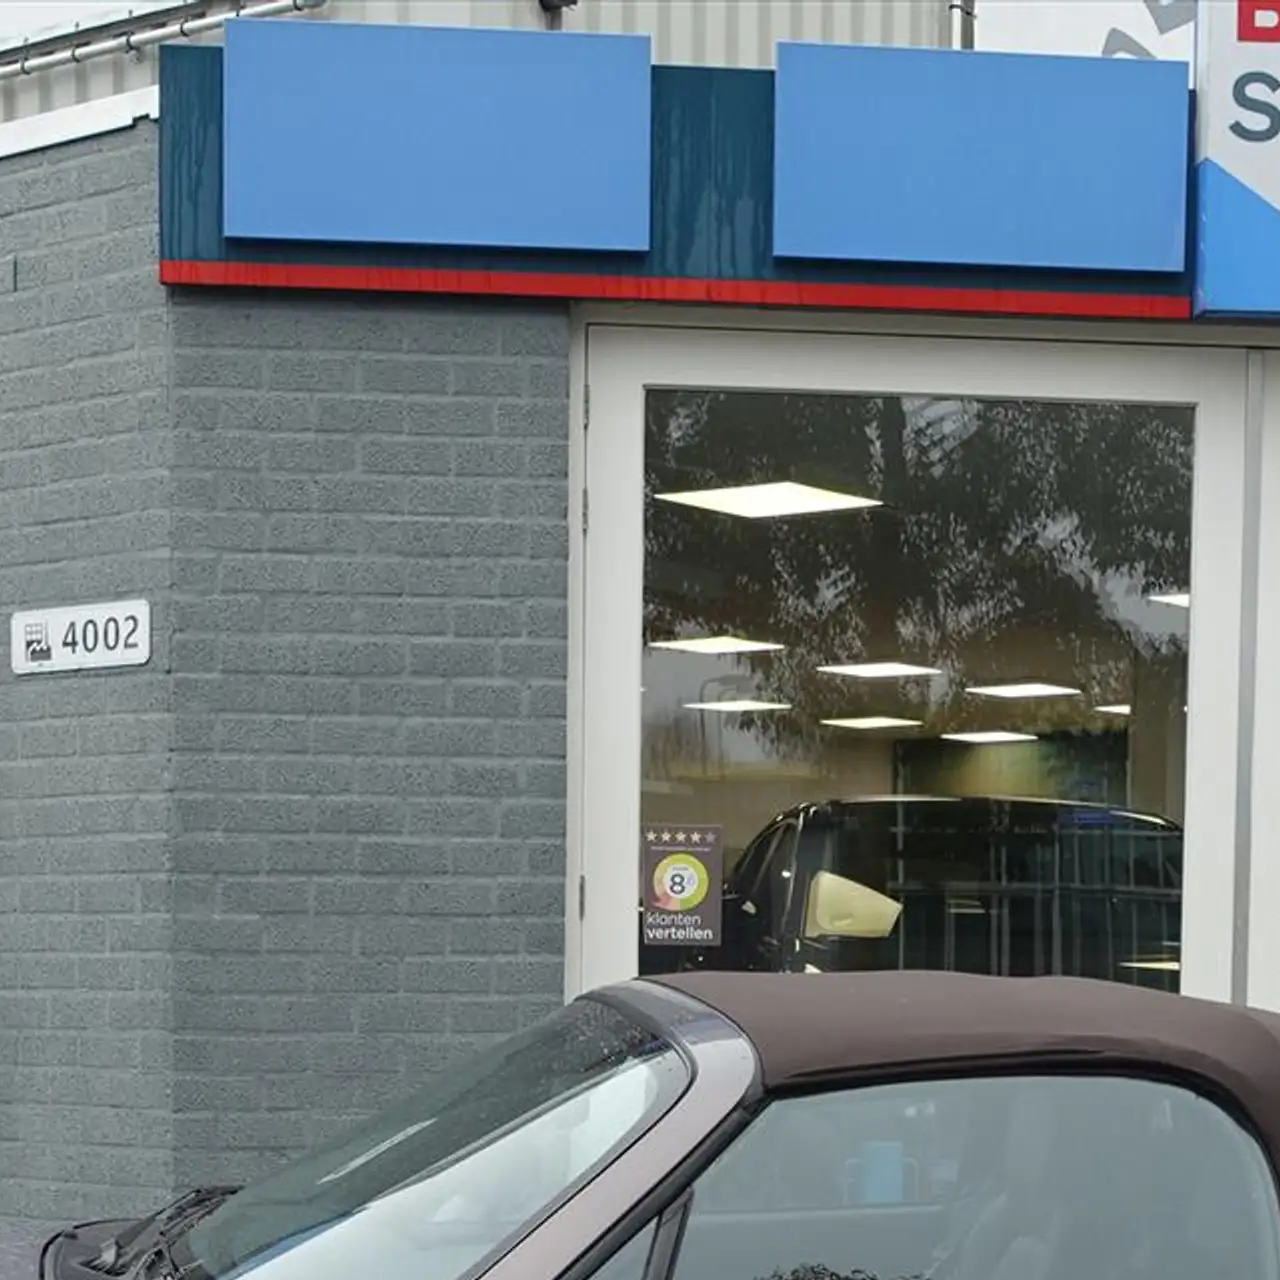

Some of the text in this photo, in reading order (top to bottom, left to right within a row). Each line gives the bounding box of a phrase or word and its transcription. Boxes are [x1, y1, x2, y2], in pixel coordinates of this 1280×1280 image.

[61, 614, 139, 654] 4002
[646, 912, 702, 926] klanten
[646, 927, 714, 941] vertellen
